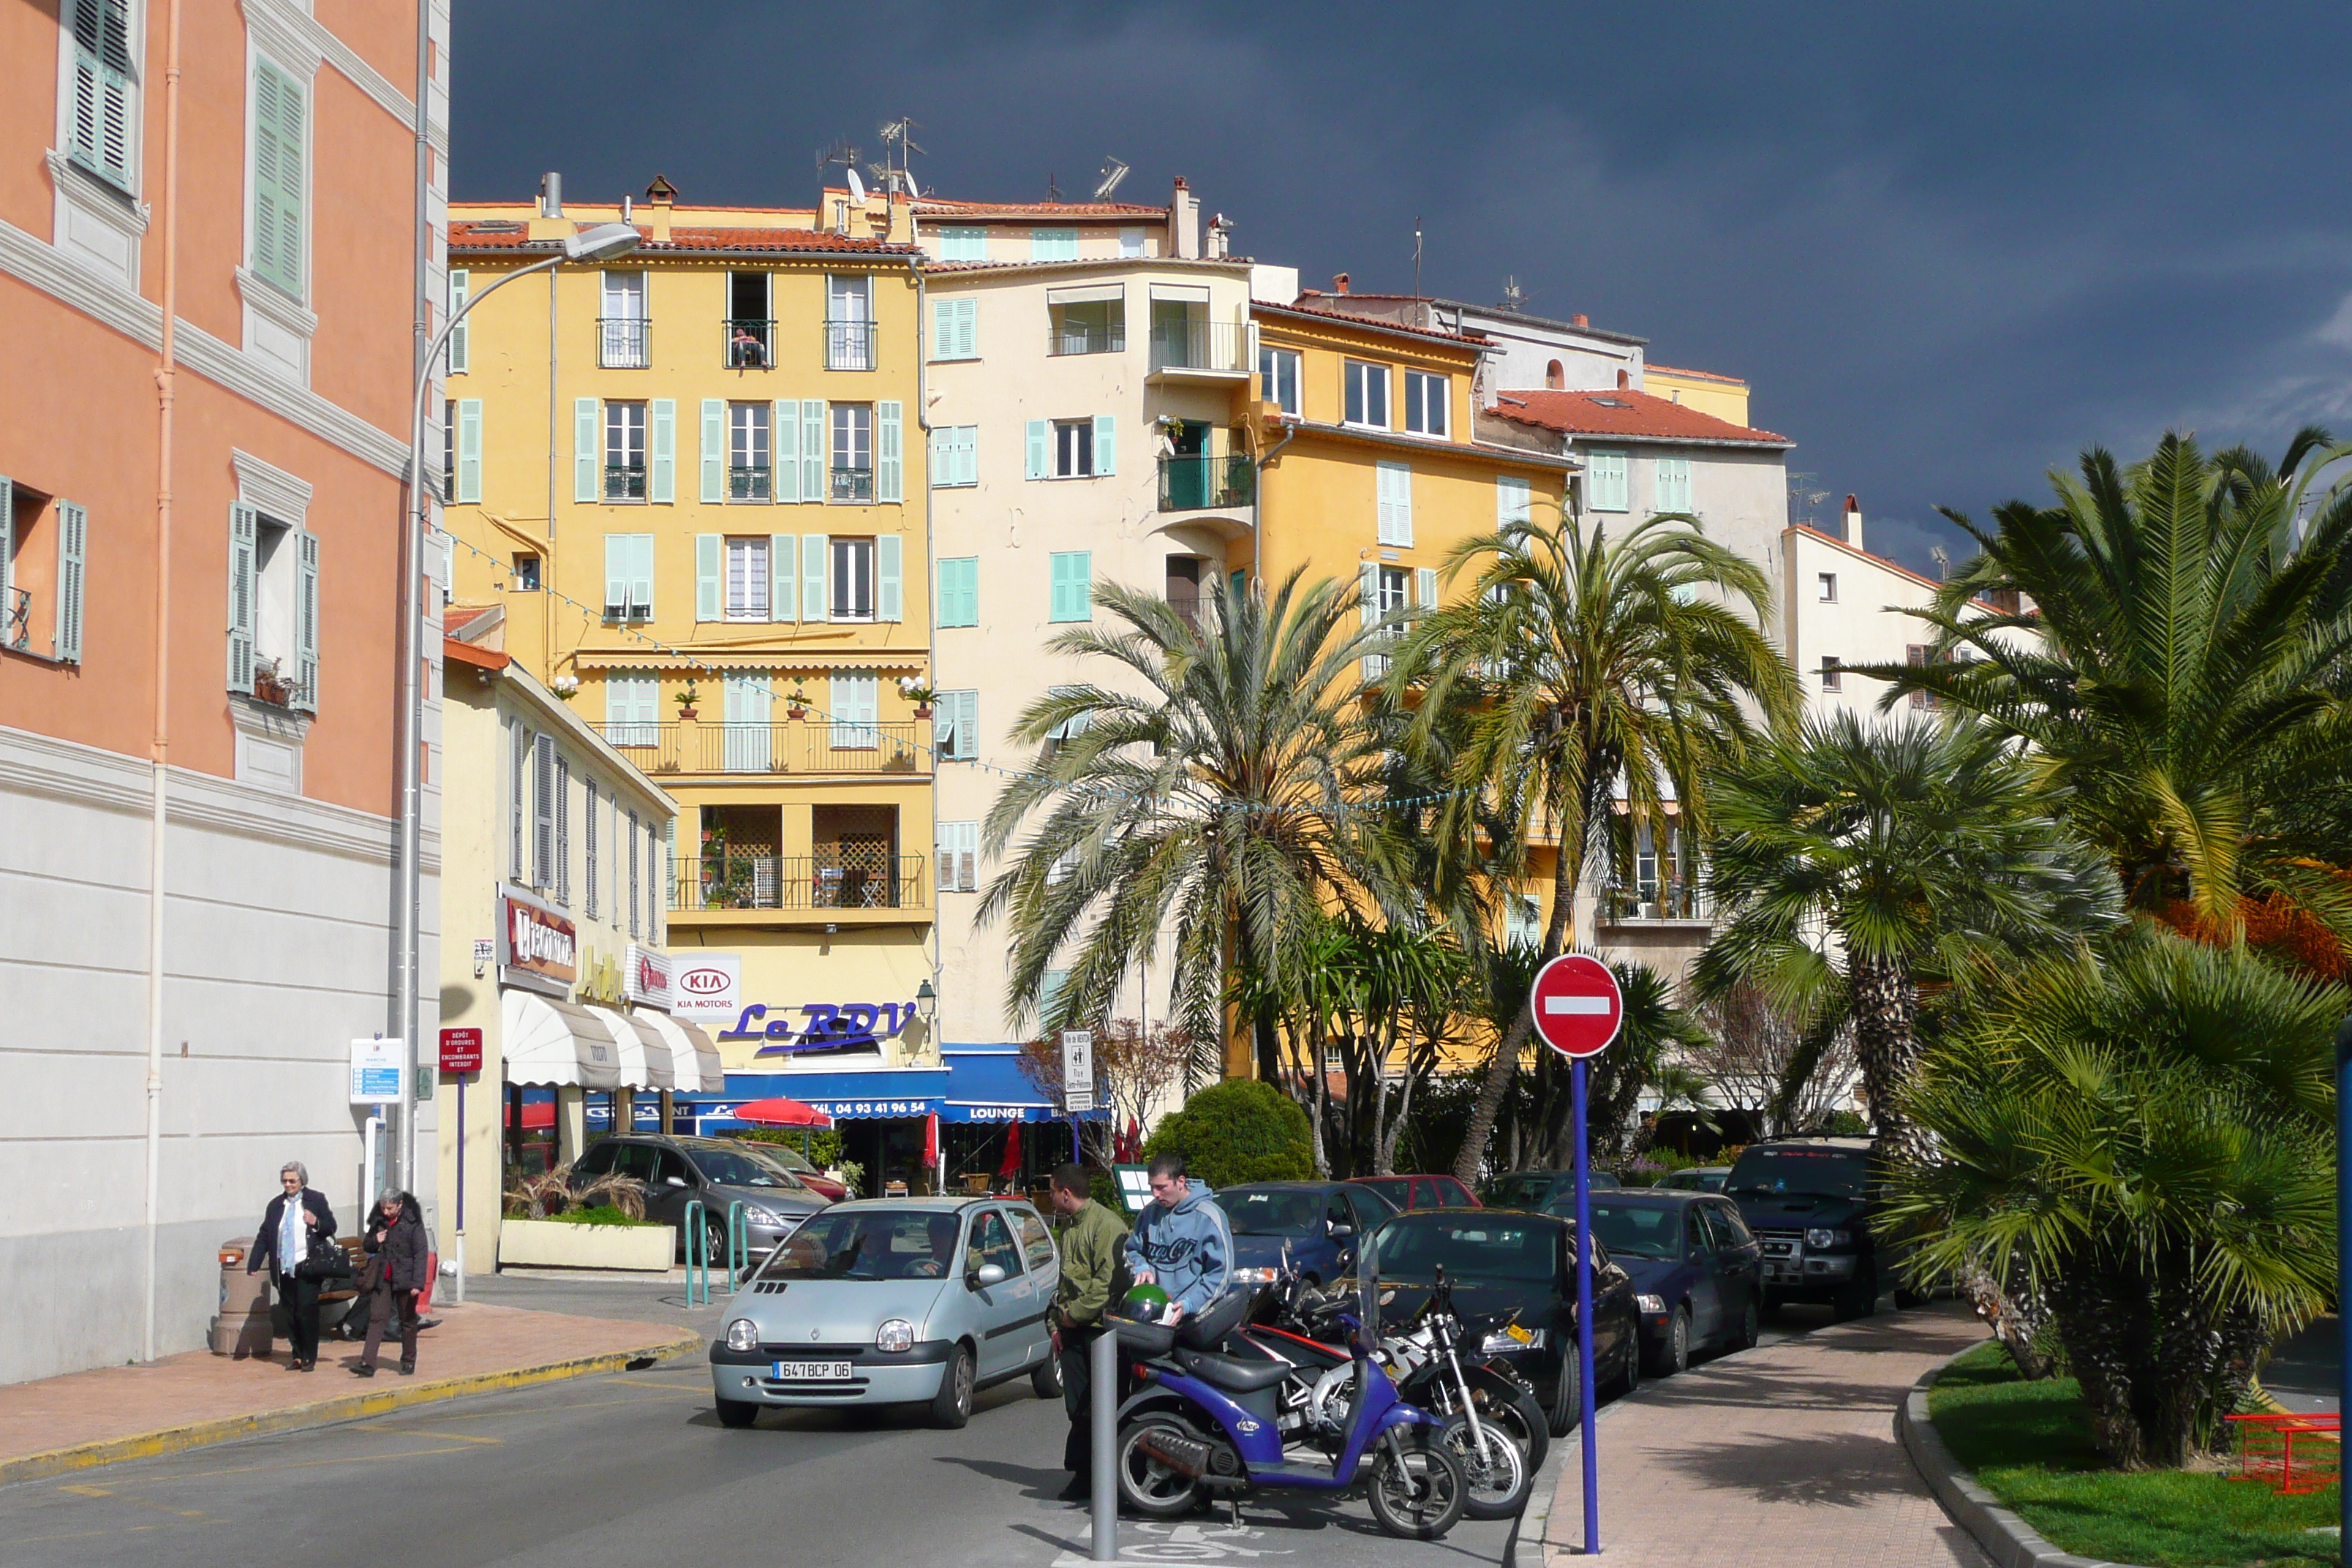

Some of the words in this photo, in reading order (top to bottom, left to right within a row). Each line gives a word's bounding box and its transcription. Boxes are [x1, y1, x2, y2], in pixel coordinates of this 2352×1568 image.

[690, 975, 722, 988] KIA
[717, 1004, 794, 1042] Le
[801, 1002, 916, 1037] RDV
[1074, 1068, 1083, 1077] Rue
[836, 1104, 851, 1114] 04
[856, 1104, 871, 1113] 93
[875, 1103, 888, 1113] 41
[891, 1102, 907, 1112] 96
[911, 1101, 925, 1112] 54
[970, 1108, 1024, 1118] LOUNGE
[834, 1364, 849, 1376] 06
